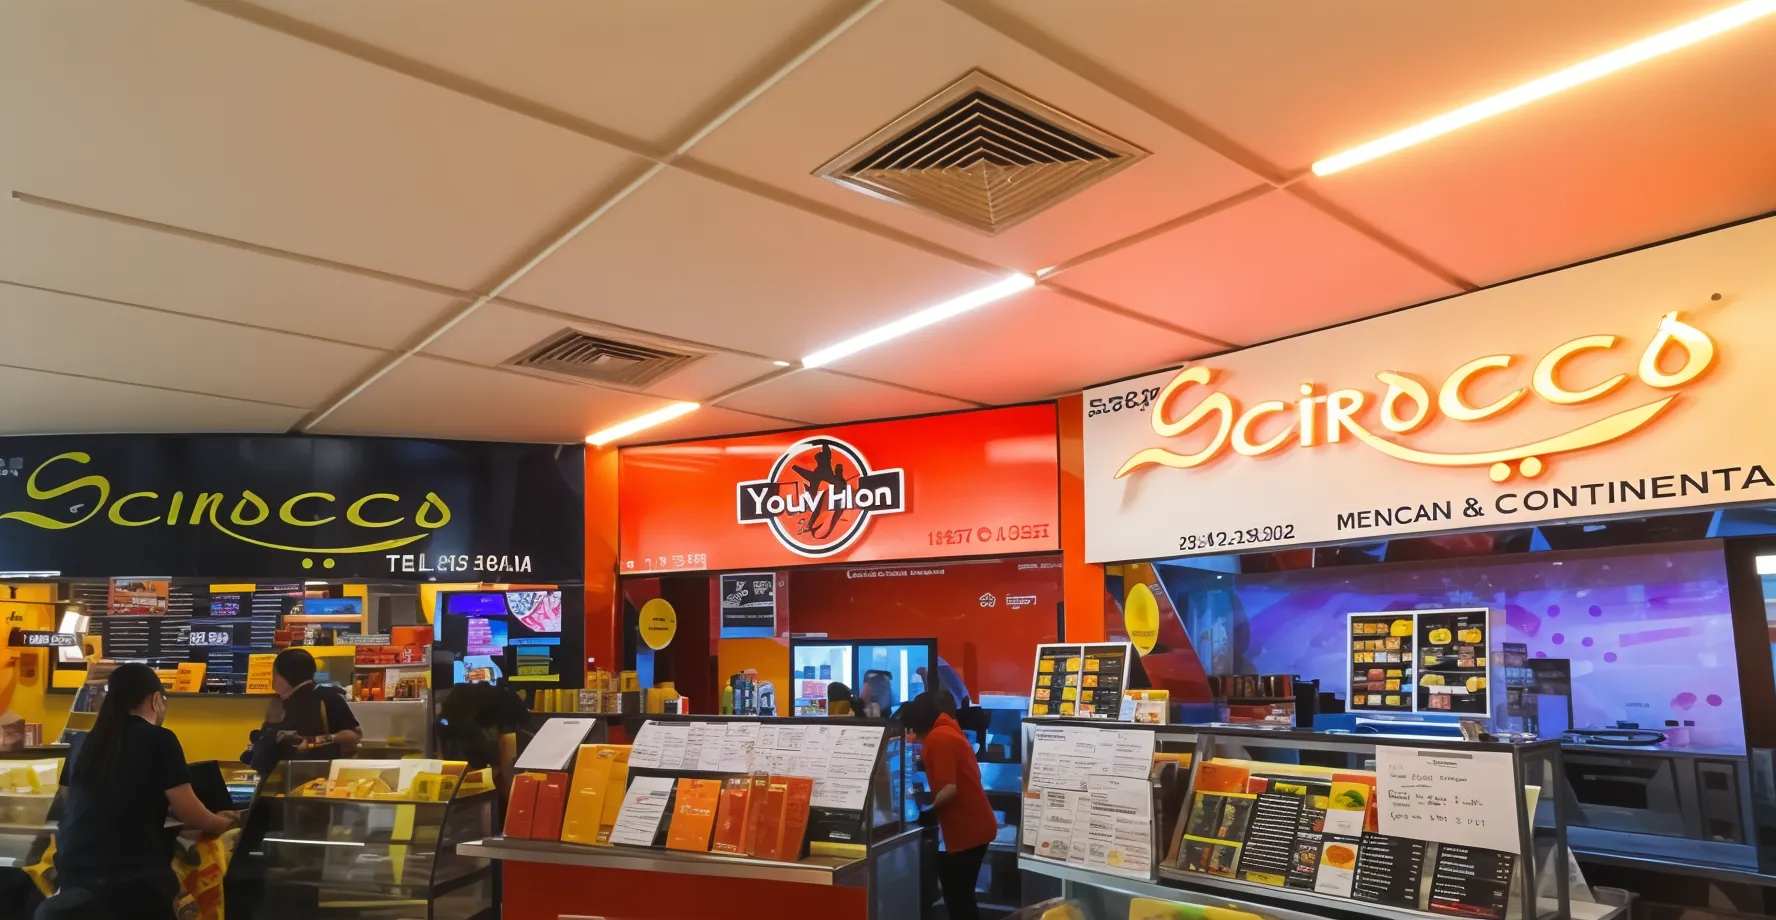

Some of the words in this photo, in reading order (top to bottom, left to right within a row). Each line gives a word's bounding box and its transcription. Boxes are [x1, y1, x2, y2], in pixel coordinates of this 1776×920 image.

[1462, 497, 1485, 518] &
[1494, 464, 1776, 515] CONTINENTA
[386, 553, 435, 573] TEL
